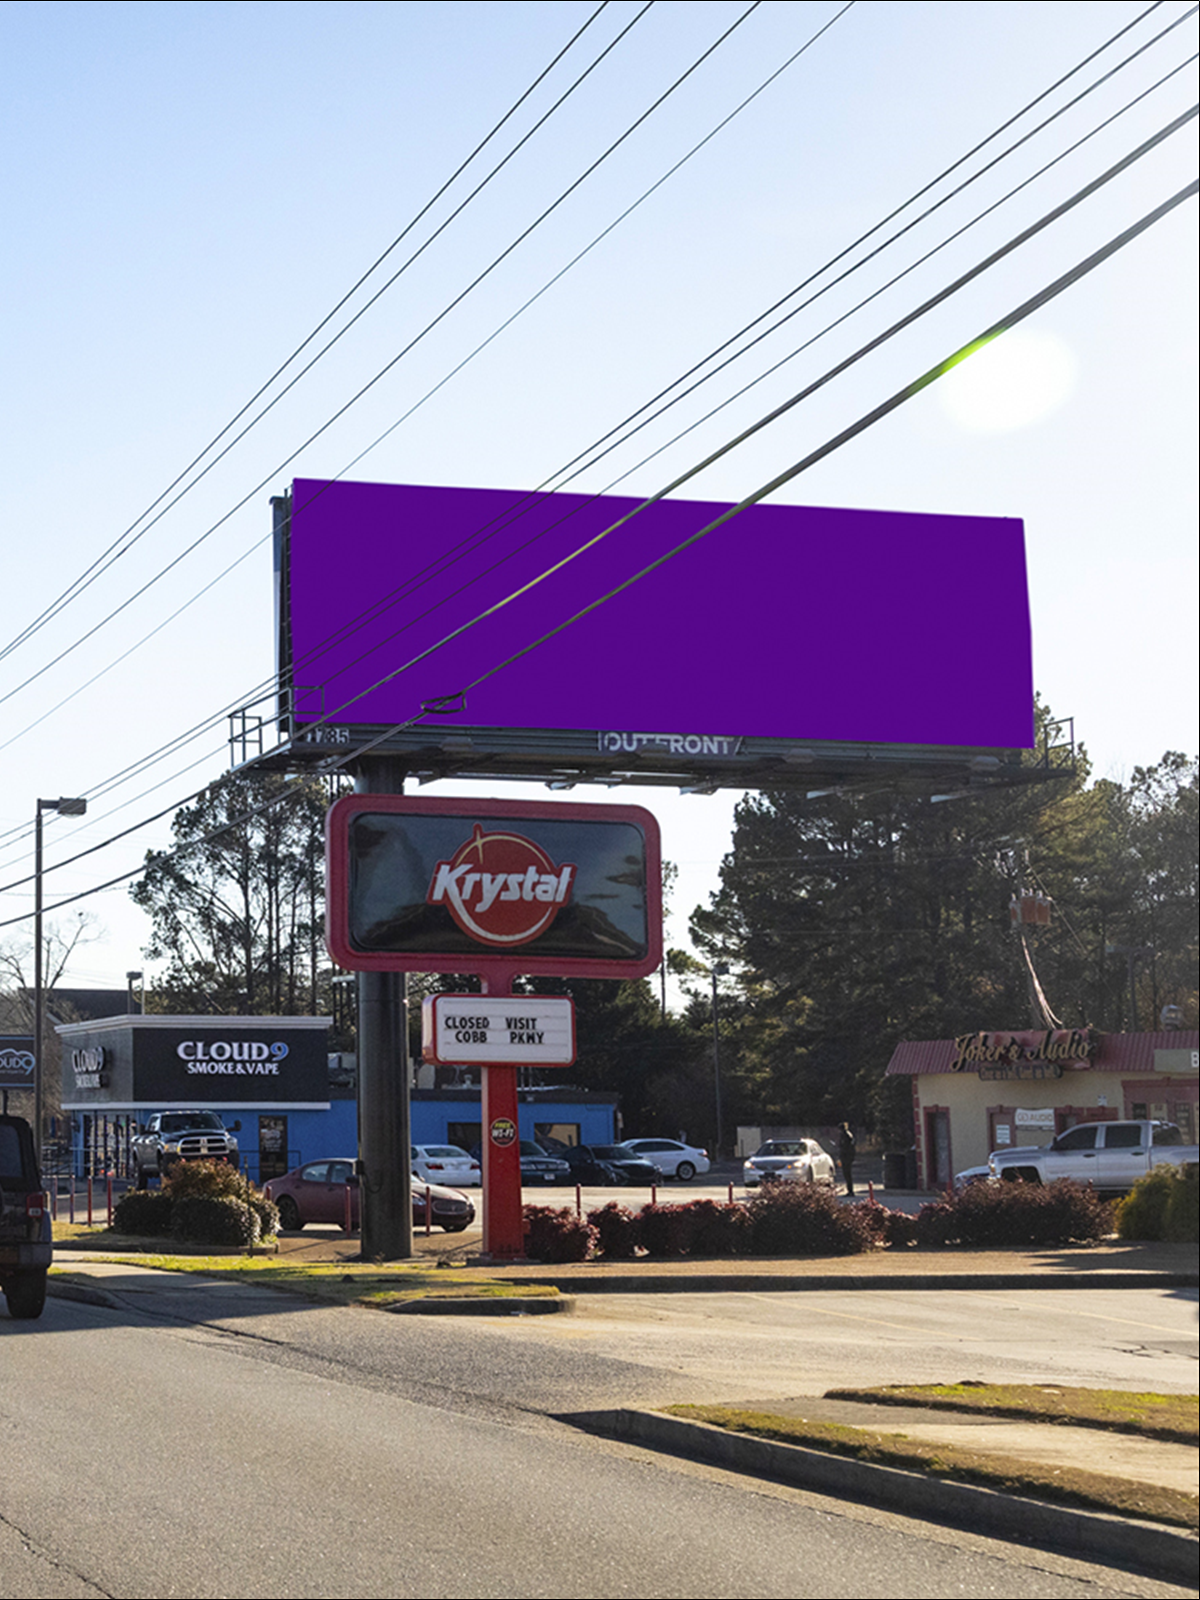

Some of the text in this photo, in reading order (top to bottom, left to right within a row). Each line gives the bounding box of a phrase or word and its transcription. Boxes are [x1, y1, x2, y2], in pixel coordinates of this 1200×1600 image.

[432, 864, 572, 912] Krystal
[445, 1016, 537, 1030] CLOSED VISIT
[455, 1031, 544, 1044] COBB PKWY
[177, 1041, 289, 1061] CLOUD9
